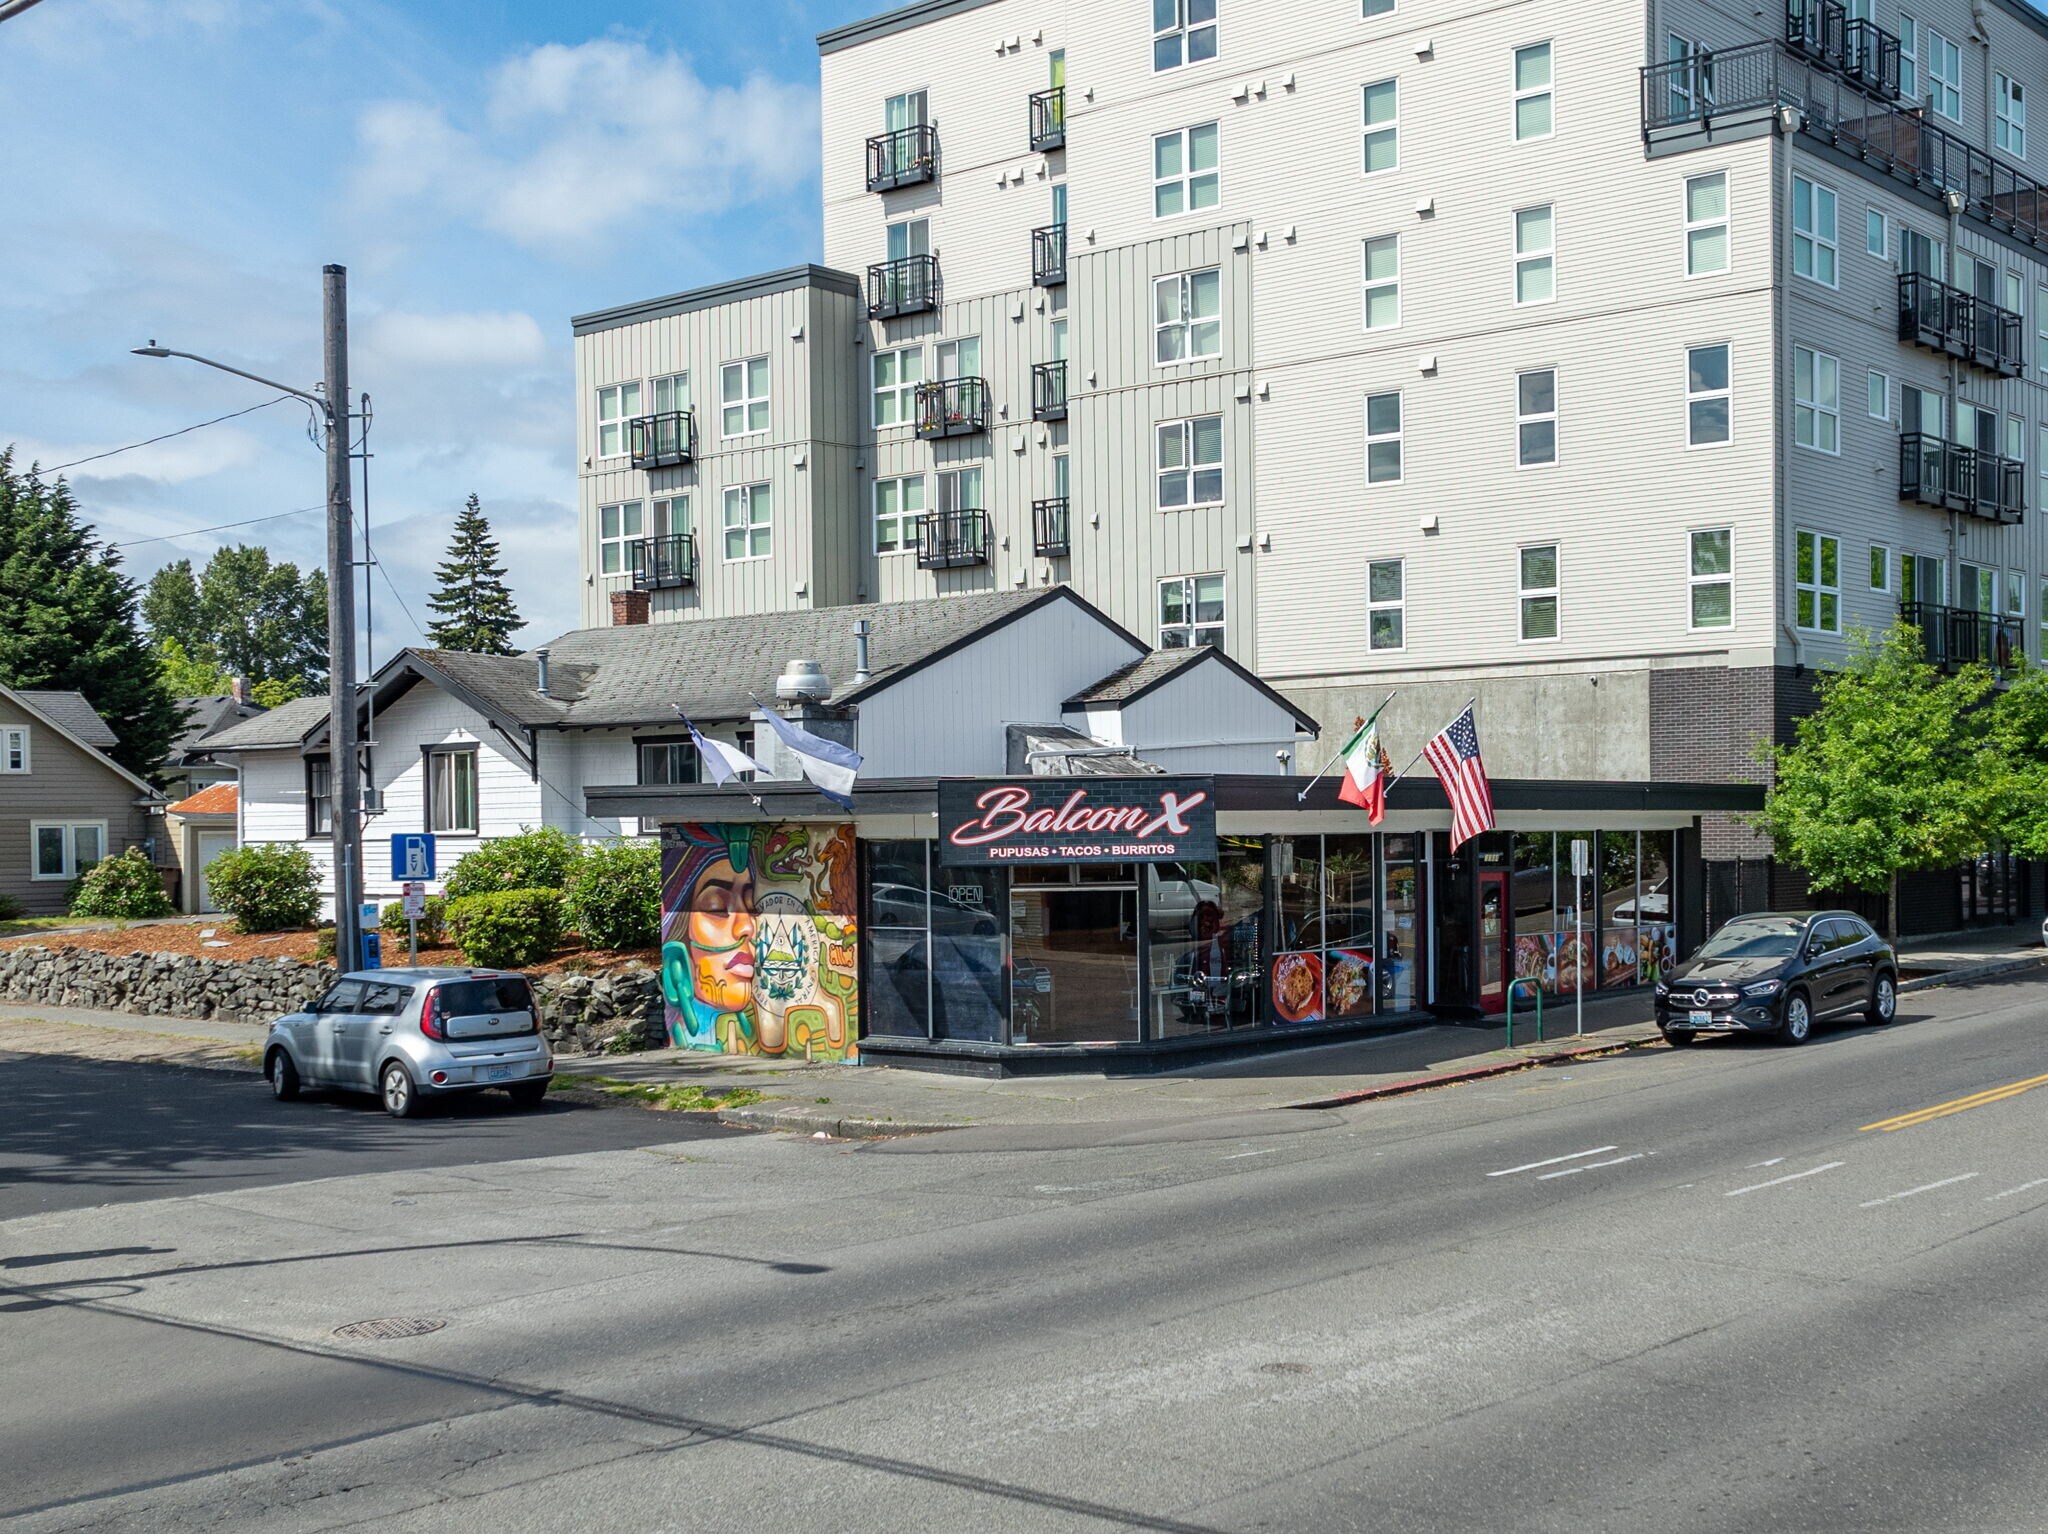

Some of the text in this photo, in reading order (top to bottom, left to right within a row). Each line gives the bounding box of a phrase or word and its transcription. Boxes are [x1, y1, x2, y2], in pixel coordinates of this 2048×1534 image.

[989, 844, 1176, 858] PUPUSAS TACOS BURRITOS
[950, 887, 981, 902] OPEN
